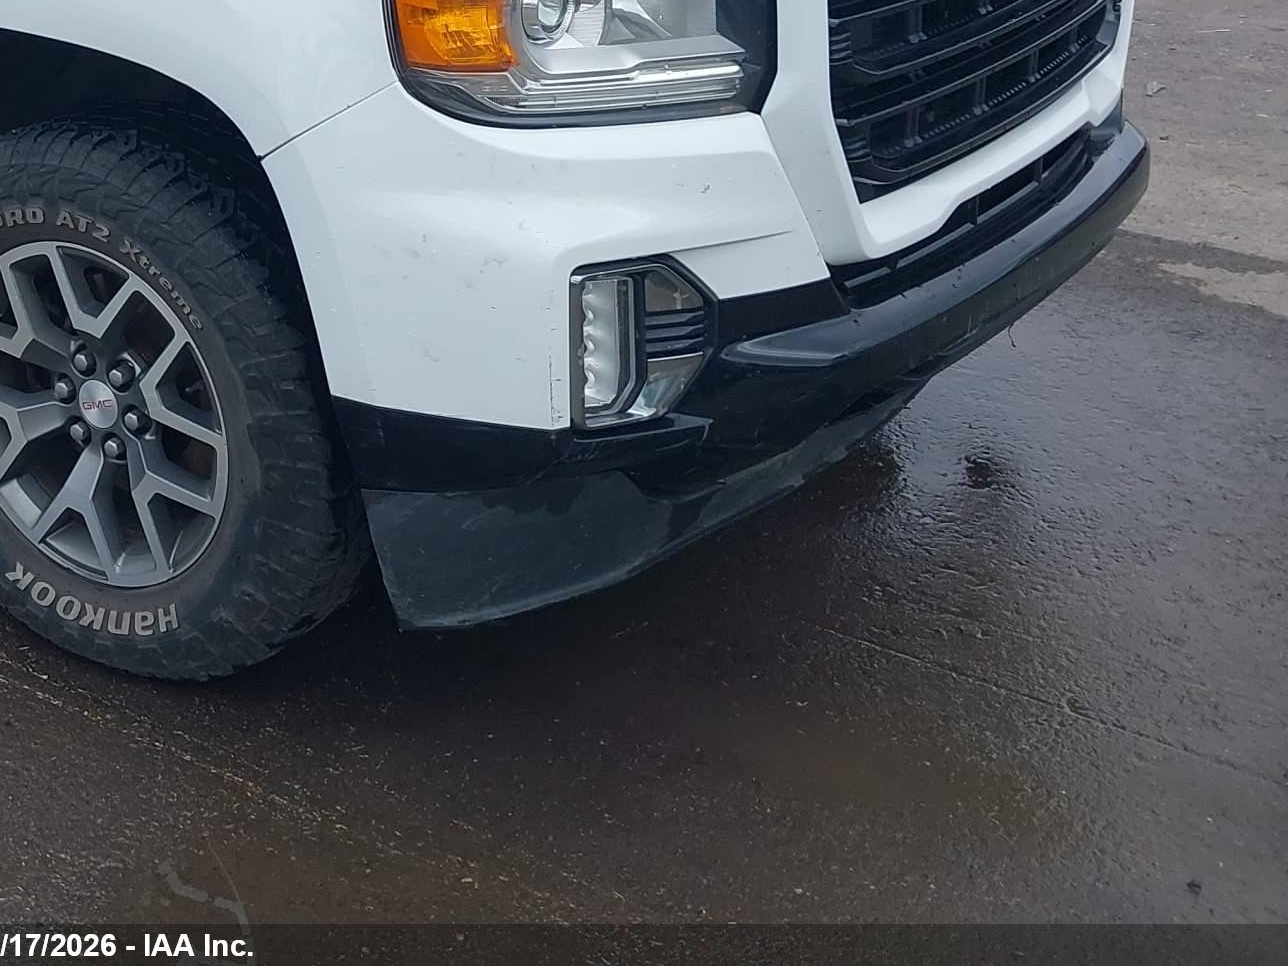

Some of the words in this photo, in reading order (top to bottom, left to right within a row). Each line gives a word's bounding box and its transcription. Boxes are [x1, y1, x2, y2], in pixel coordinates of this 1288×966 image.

[55, 210, 111, 243] AT2
[119, 238, 203, 331] Xtreme
[82, 399, 113, 410] GMC
